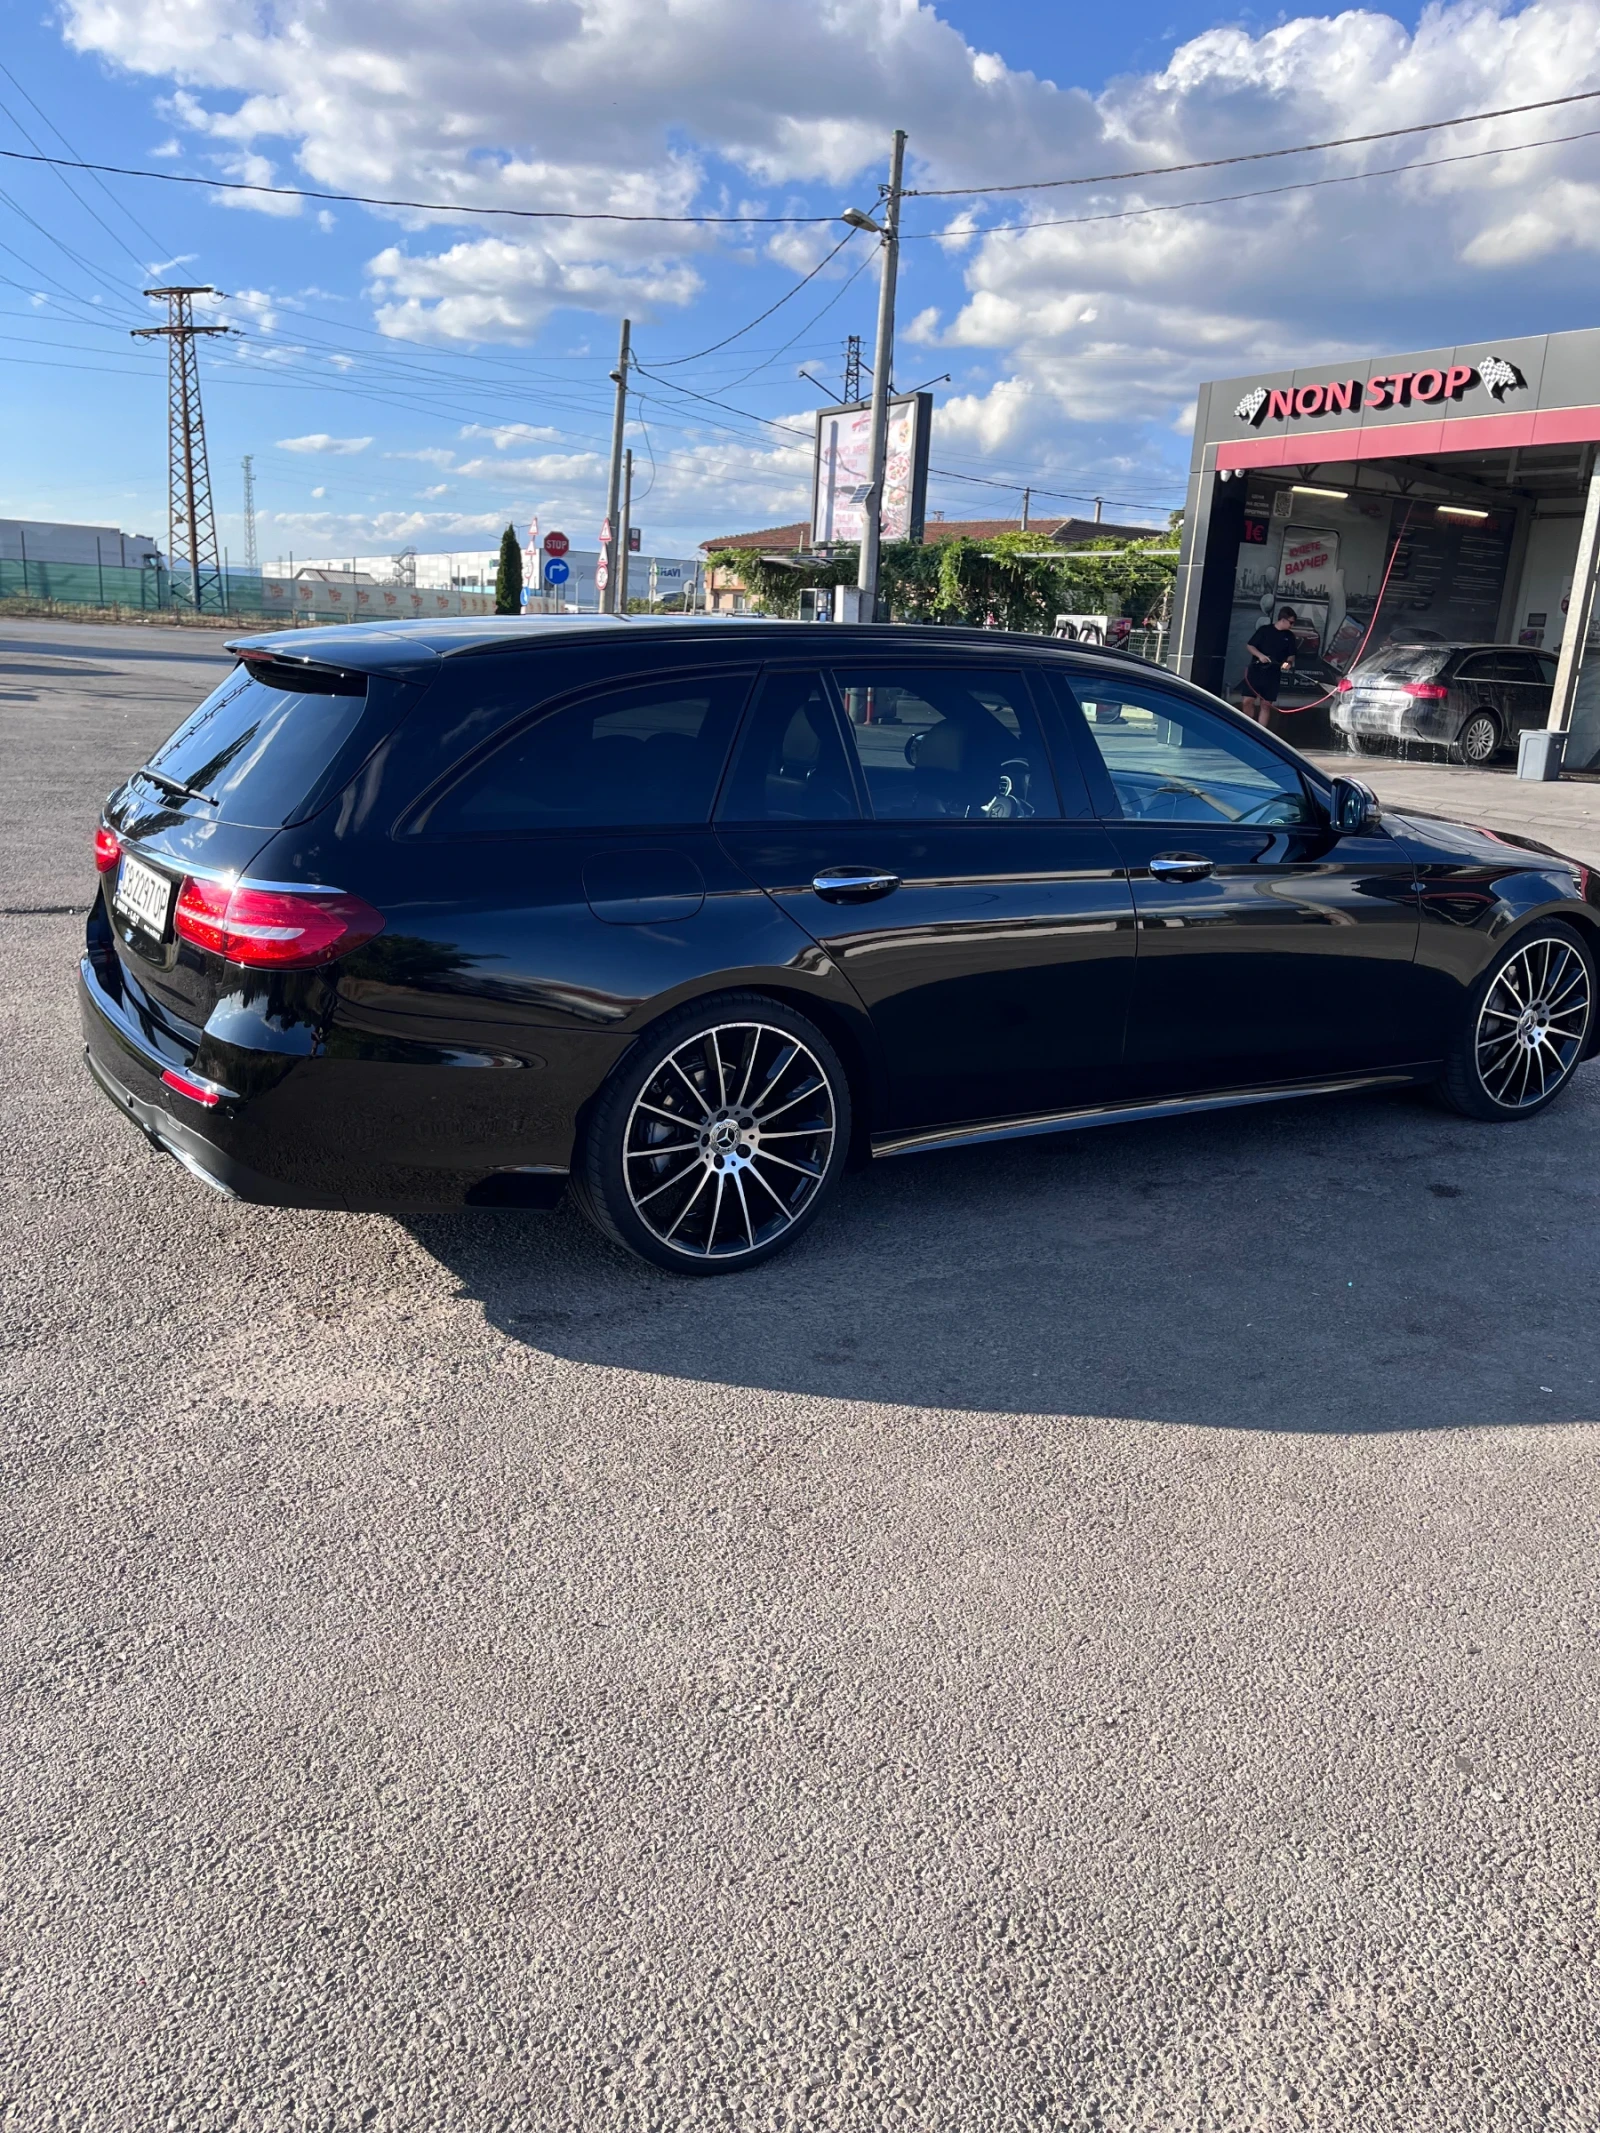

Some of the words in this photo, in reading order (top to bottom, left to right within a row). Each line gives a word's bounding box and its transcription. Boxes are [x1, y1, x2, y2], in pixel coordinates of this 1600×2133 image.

[1267, 379, 1354, 418] NON
[1364, 365, 1472, 406] STOP
[546, 538, 568, 550] STOP
[660, 567, 681, 578] HAVI
[1285, 553, 1329, 575] ВАУЧЕР
[132, 870, 156, 913] 2297
